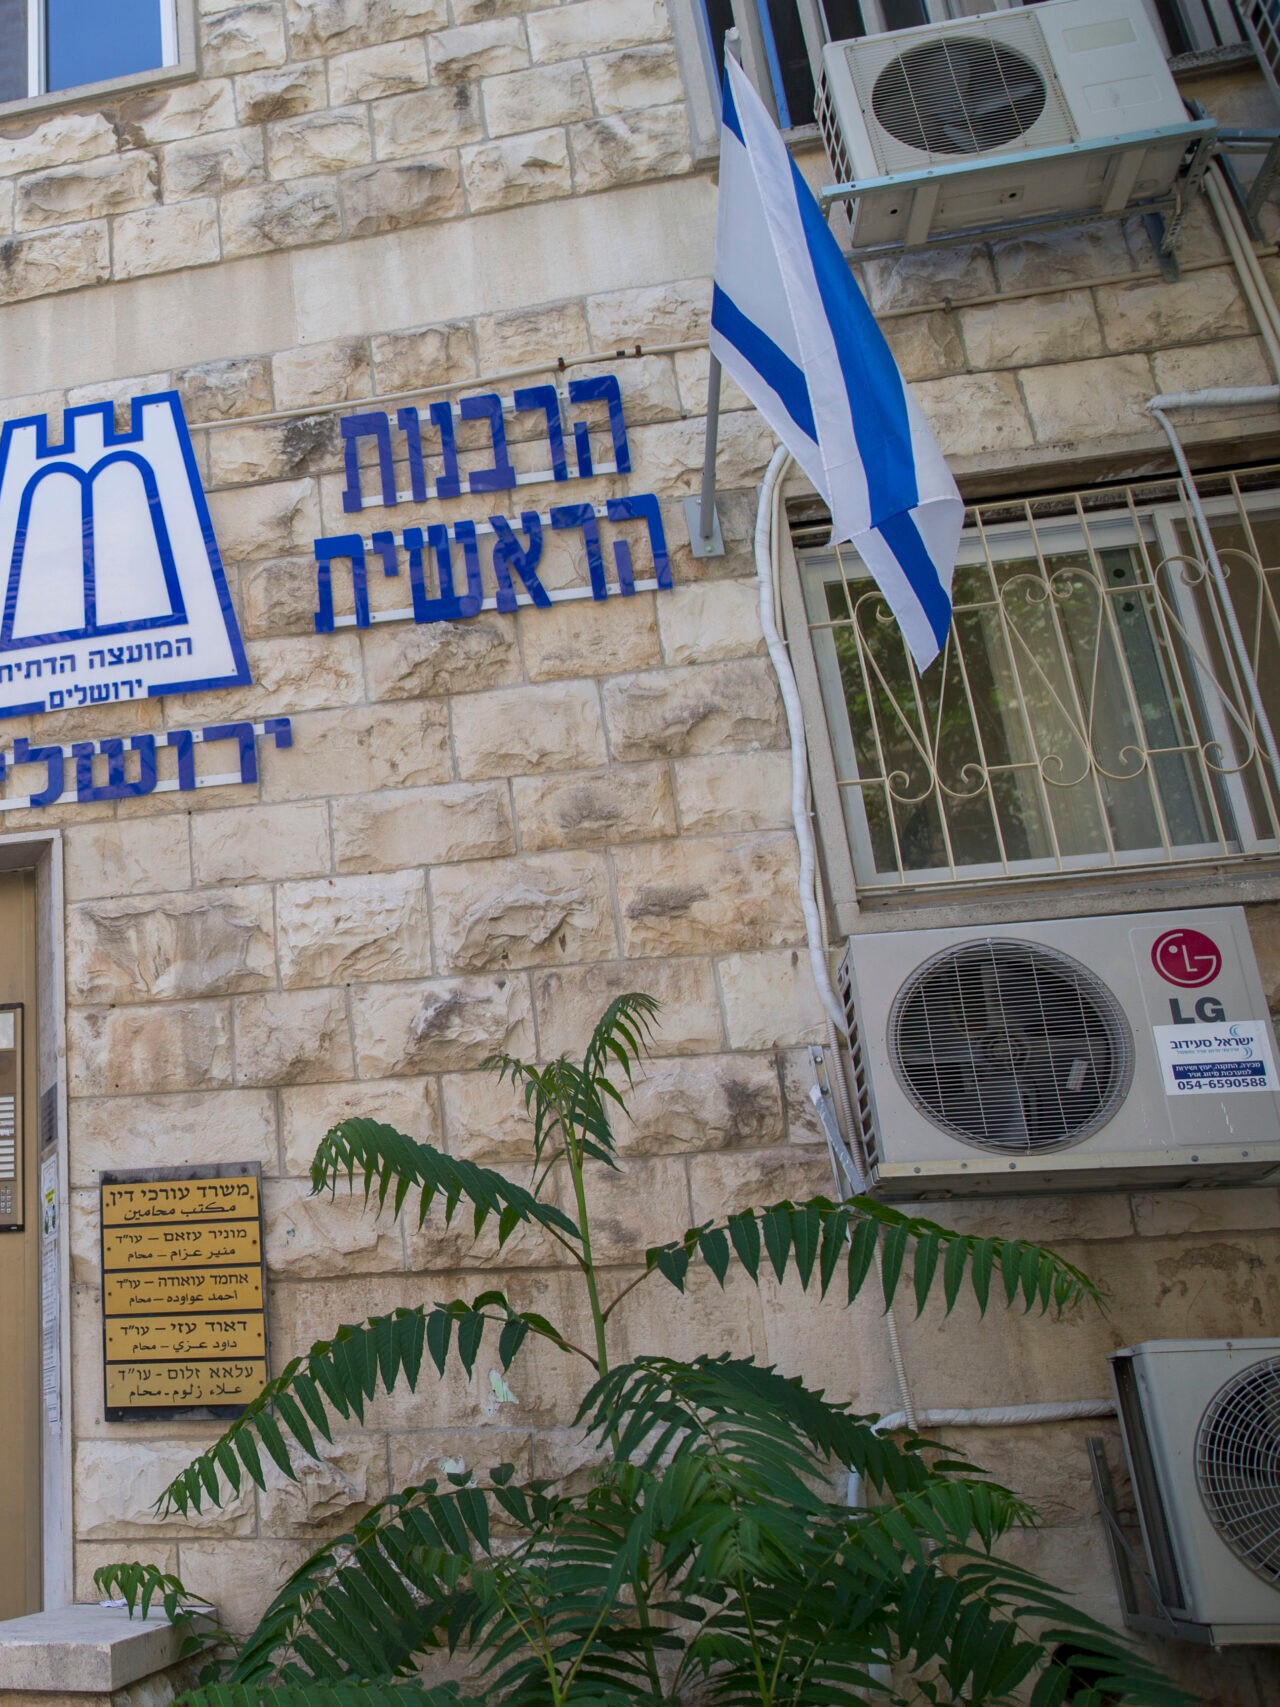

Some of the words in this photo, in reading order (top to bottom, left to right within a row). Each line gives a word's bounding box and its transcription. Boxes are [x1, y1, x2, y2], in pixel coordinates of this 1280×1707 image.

[340, 374, 631, 513] הרבנות
[314, 492, 673, 634] הראשית
[89, 637, 192, 670] המועצה
[49, 678, 142, 710] ירושלים
[1169, 997, 1226, 1025] LG
[1170, 1040, 1212, 1049] סעידוב
[1214, 1037, 1254, 1046] ישראל
[1178, 1078, 1267, 1090] 054-6590588
[140, 1187, 190, 1200] עורכי
[197, 1184, 249, 1198] משרד
[109, 1190, 134, 1206] דין
[124, 1206, 175, 1220] محامين
[181, 1202, 236, 1217] مكتب
[116, 1234, 142, 1244] עו"ד
[164, 1231, 202, 1242] עזאם
[208, 1229, 247, 1239] מוניר
[128, 1252, 153, 1262] محام
[170, 1250, 202, 1260] عزام
[207, 1248, 235, 1259] منير
[116, 1279, 141, 1289] עו"ד
[158, 1275, 205, 1287] עואודה
[210, 1273, 248, 1284] אחמד
[129, 1296, 152, 1306] محام
[167, 1293, 203, 1305] عواوده
[208, 1290, 238, 1300] أحمد
[120, 1325, 150, 1336] עו"ד
[170, 1322, 197, 1334] עזי
[205, 1320, 247, 1332] דאוד
[132, 1343, 156, 1353] محام
[173, 1341, 207, 1352] عزي
[213, 1340, 237, 1351] داود
[118, 1368, 151, 1381] עו"ד
[168, 1366, 200, 1379] זלום
[209, 1365, 254, 1378] עלאא
[129, 1385, 161, 1403] محام
[173, 1384, 202, 1402] زلوم
[210, 1383, 242, 1396] علاء
